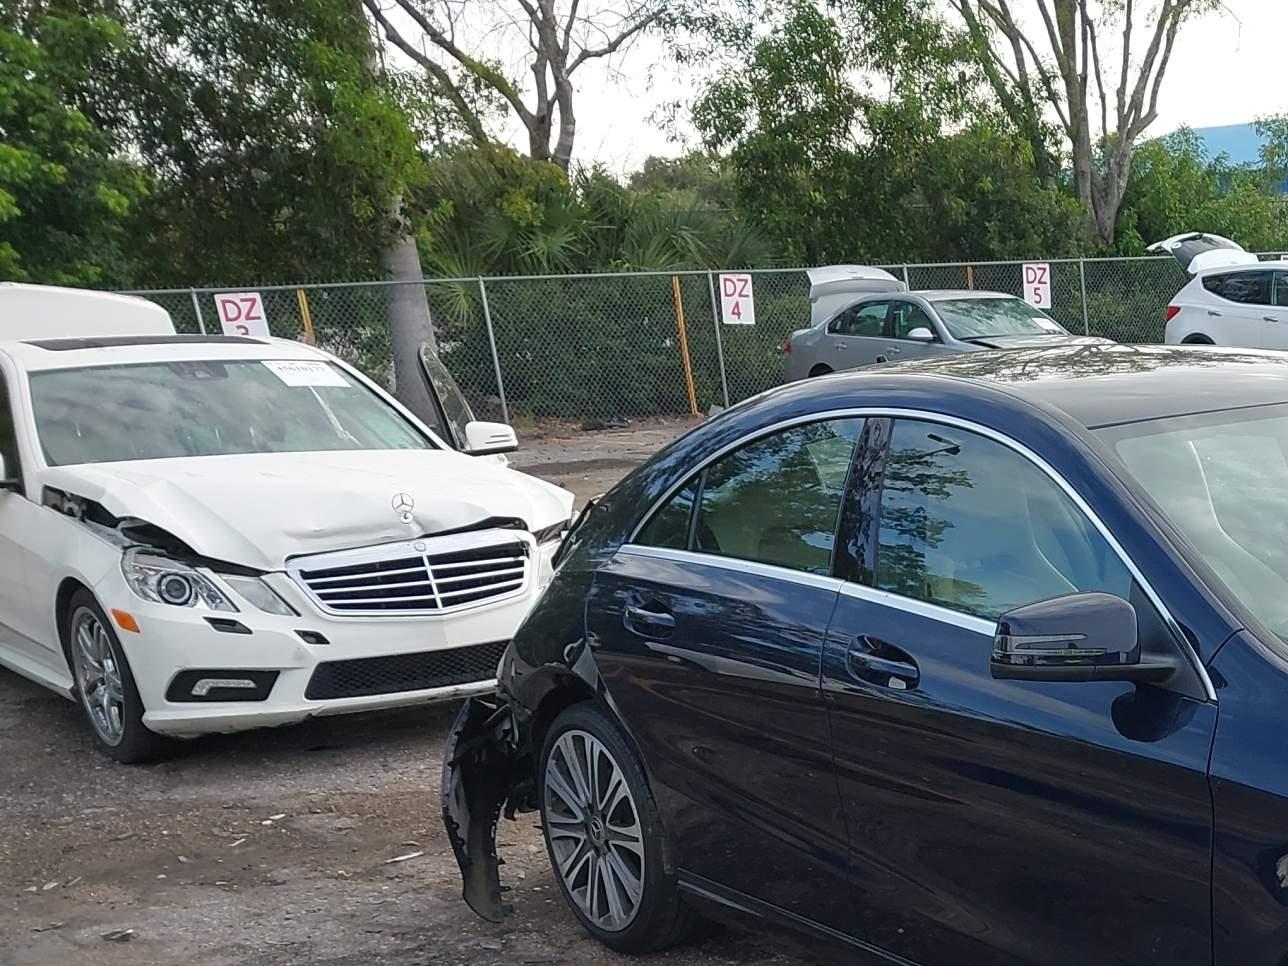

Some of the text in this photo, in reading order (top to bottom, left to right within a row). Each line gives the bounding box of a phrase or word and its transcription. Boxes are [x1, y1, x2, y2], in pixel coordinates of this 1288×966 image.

[1025, 266, 1048, 285] DZ
[723, 278, 750, 298] DZ
[1033, 287, 1042, 304] 5
[221, 297, 262, 322] DZ
[731, 301, 742, 320] 4
